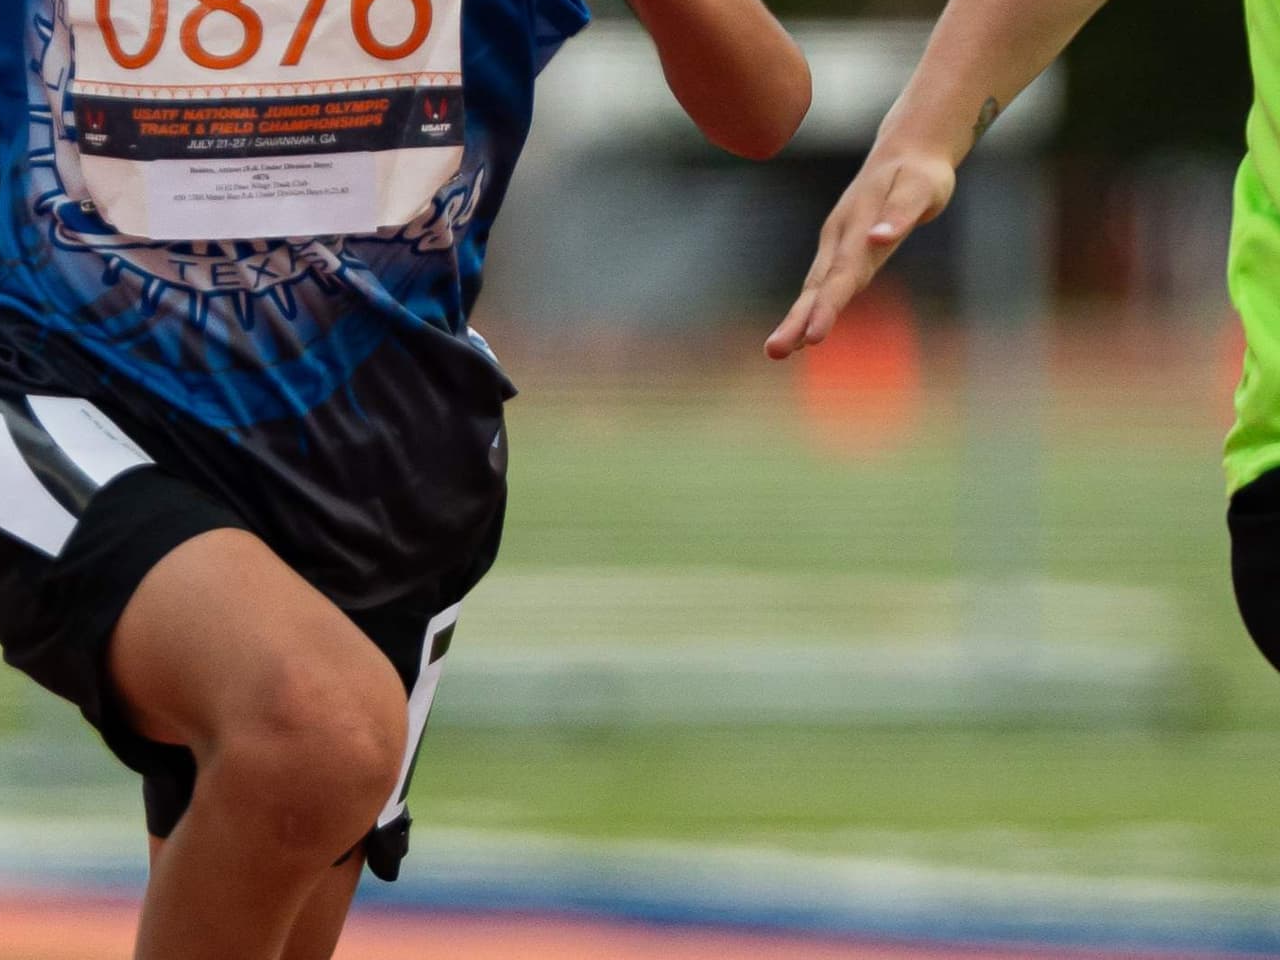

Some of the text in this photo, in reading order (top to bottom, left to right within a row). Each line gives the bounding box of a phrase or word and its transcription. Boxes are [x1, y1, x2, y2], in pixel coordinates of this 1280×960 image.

[132, 98, 389, 120] USATF NATIONAL JUNIOR OLYMPIC
[140, 122, 190, 136] TRACK
[209, 122, 254, 135] FIELD
